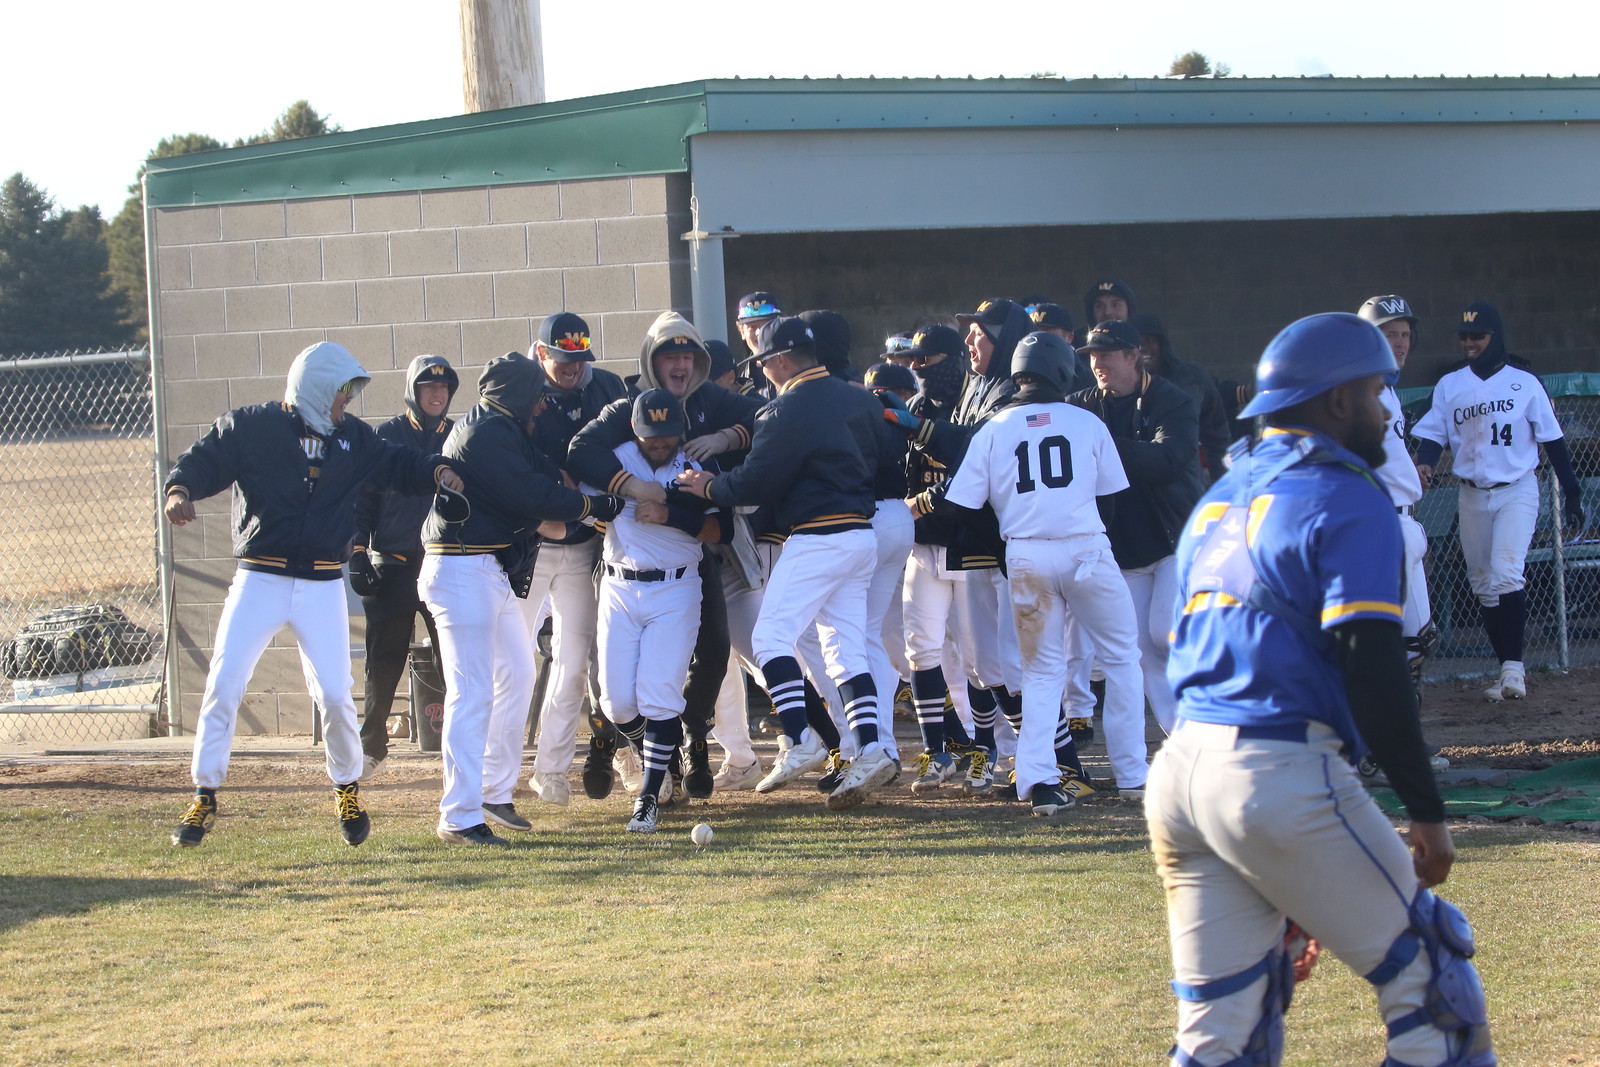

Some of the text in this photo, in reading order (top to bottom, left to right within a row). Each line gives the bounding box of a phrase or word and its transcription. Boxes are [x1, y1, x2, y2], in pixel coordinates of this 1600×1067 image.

[1379, 300, 1405, 314] W
[1463, 311, 1478, 323] W
[431, 366, 445, 376] W
[648, 408, 669, 423] W
[1453, 399, 1515, 426] COUGARS
[1491, 423, 1513, 447] 14
[1015, 435, 1074, 495] 10
